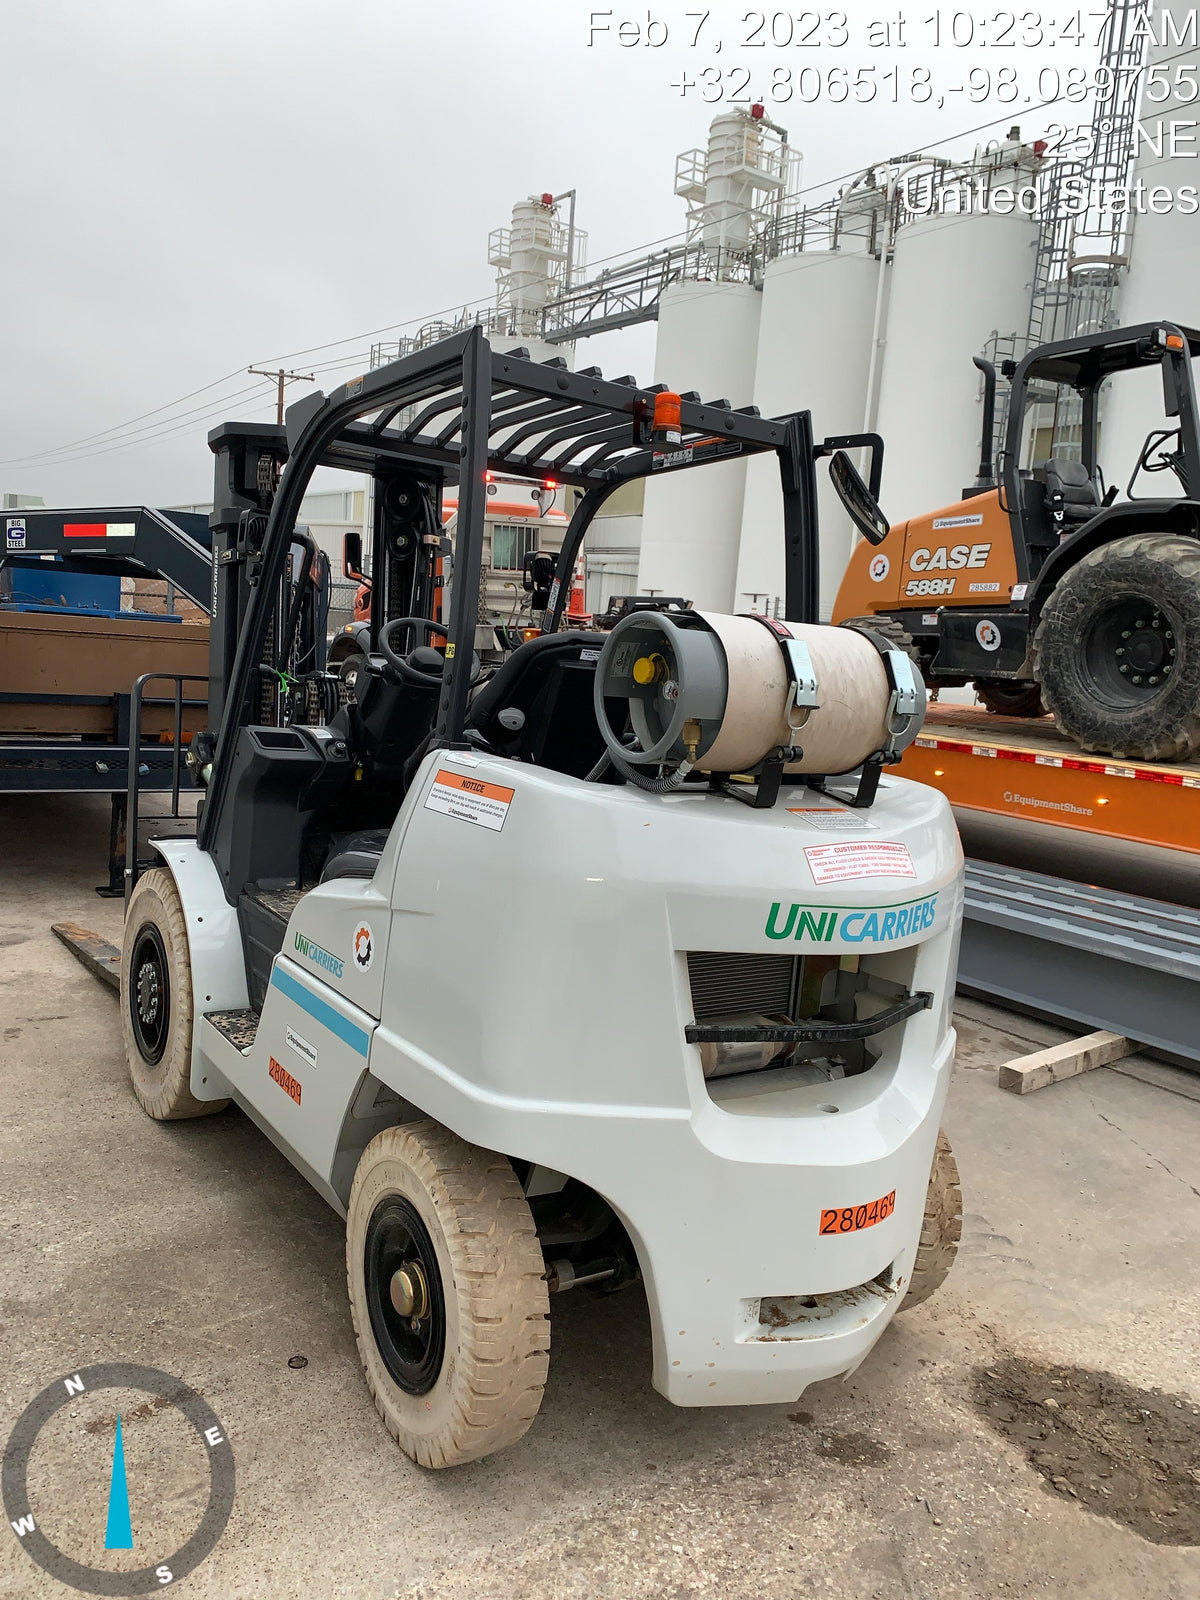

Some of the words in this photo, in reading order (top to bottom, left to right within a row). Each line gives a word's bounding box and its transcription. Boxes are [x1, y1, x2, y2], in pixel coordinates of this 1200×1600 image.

[11, 519, 21, 527] BIG
[939, 517, 981, 528] EquipmentShare
[8, 527, 25, 540] G
[8, 540, 25, 548] STEEL
[909, 543, 992, 573] CASE
[905, 577, 957, 597] 588H
[970, 583, 999, 592] 285882
[461, 779, 486, 794] NOTICE
[1013, 793, 1094, 817] EquipmentShare
[833, 844, 867, 854] CUSTOMER
[269, 1057, 302, 1100] 280469
[821, 1189, 896, 1234] 280469
